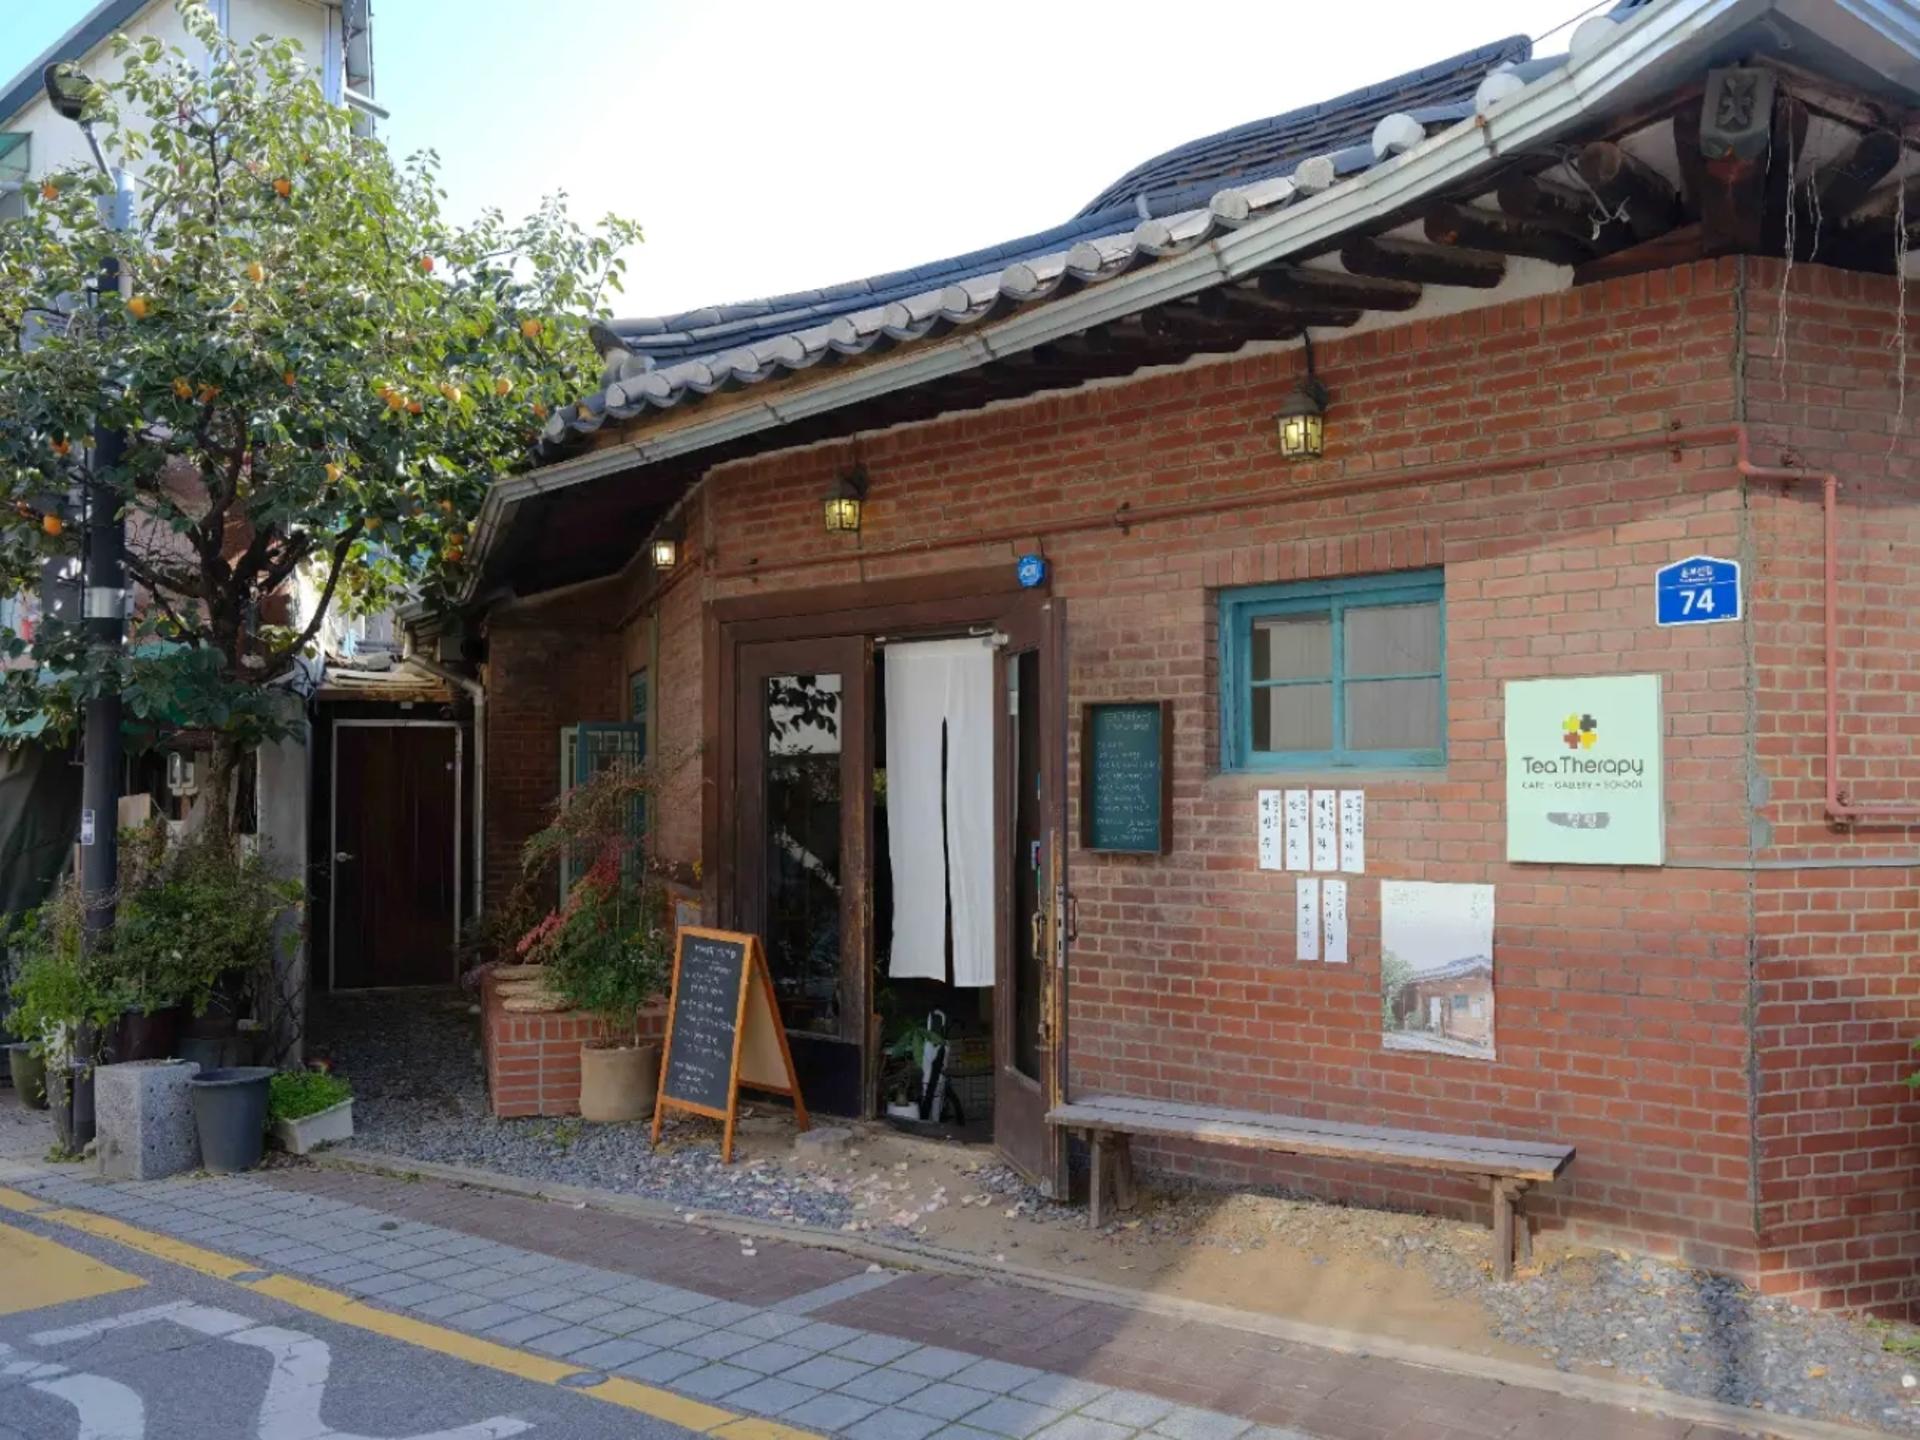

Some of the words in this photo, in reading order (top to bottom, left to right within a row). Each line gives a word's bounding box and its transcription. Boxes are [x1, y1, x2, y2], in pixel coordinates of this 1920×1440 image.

[1679, 588, 1716, 615] 74
[1521, 756, 1558, 775] Tea
[1559, 755, 1645, 776] Therapy
[1554, 780, 1593, 790] GALLERY
[1603, 779, 1644, 790] SCHOOL
